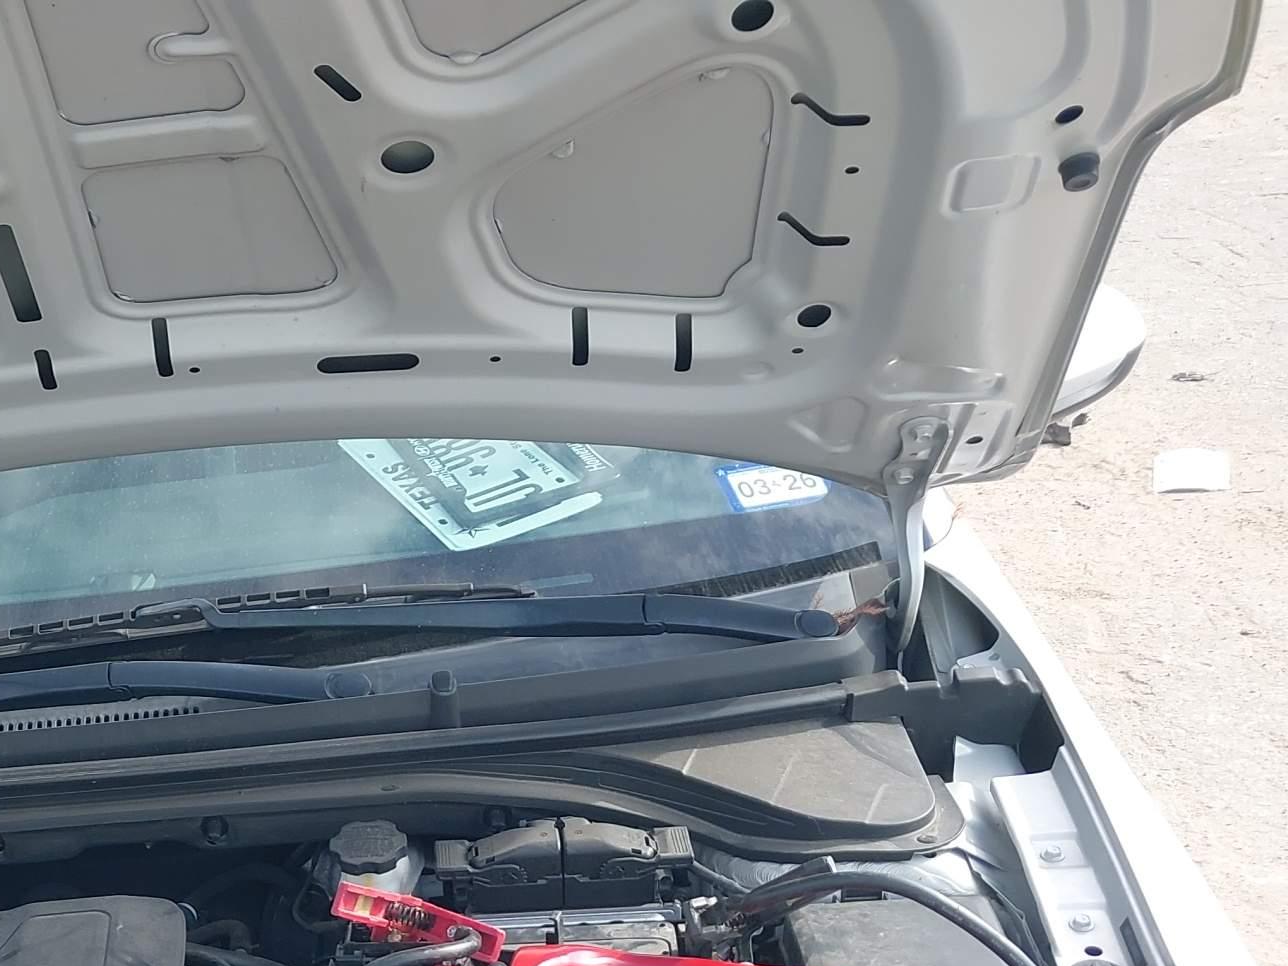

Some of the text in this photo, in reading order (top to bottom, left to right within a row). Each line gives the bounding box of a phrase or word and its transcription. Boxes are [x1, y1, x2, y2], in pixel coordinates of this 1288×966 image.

[520, 448, 545, 467] Lone
[535, 461, 552, 477] The
[382, 462, 439, 511] TEXAS
